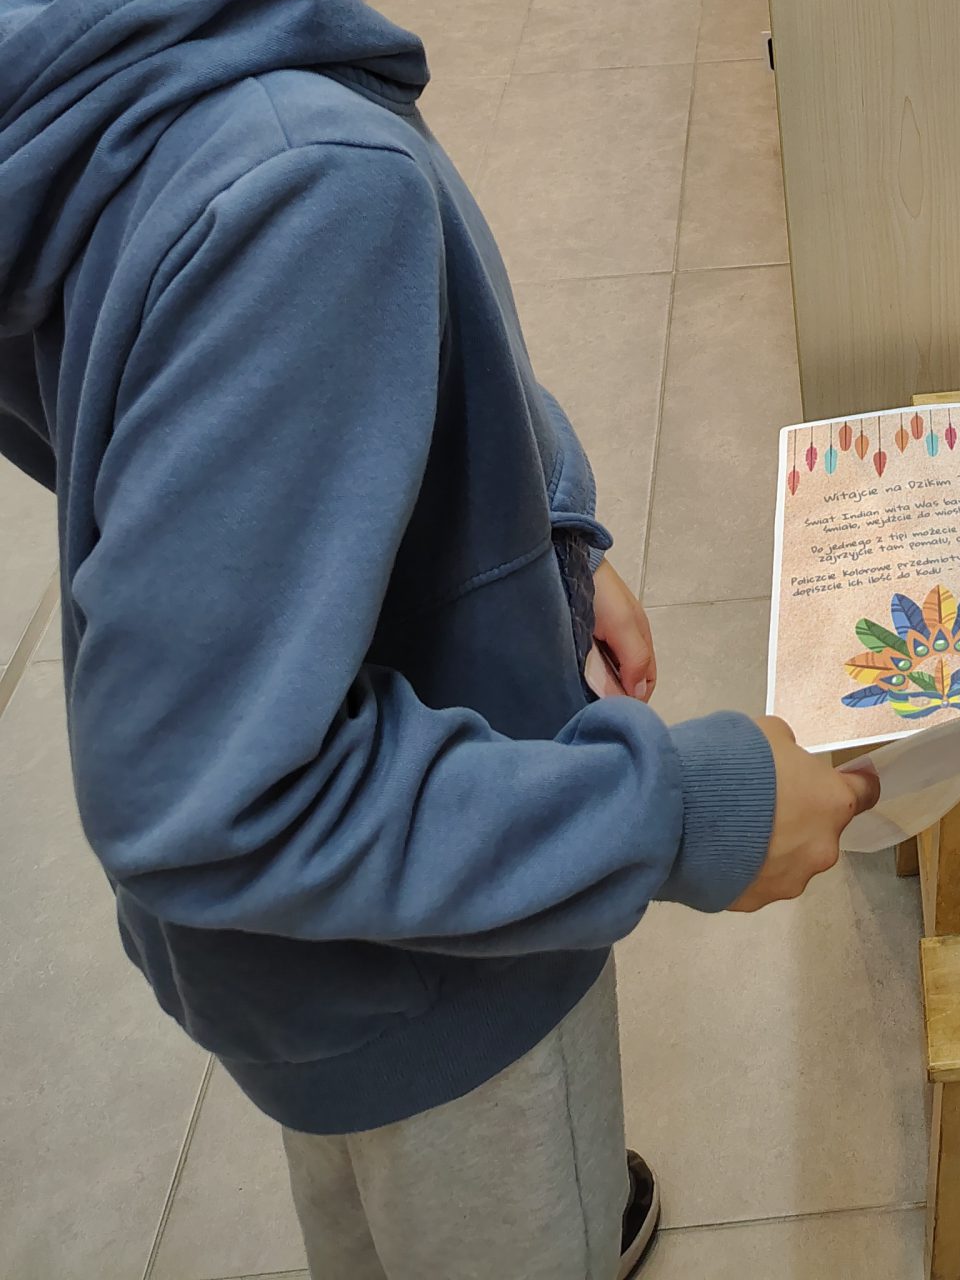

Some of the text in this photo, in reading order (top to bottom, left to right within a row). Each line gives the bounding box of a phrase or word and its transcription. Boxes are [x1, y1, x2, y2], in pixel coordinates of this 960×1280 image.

[824, 487, 878, 503] Witajcie
[885, 484, 902, 494] na
[908, 478, 951, 490] Dzikim
[804, 515, 836, 527] Świat
[842, 509, 880, 521] Indian
[885, 503, 911, 514] wita
[915, 500, 939, 509] Was
[917, 510, 930, 519] do
[811, 545, 824, 555] Do
[826, 539, 872, 556] jednego
[888, 531, 908, 542] tipi
[912, 525, 957, 538] możecie
[819, 548, 873, 564] zajrzyjcie
[880, 543, 904, 554] tam
[791, 572, 836, 587] Policzcie
[792, 582, 843, 597] dopiszcie
[848, 578, 864, 588] ich
[868, 573, 892, 585] ilość
[897, 571, 911, 580] do
